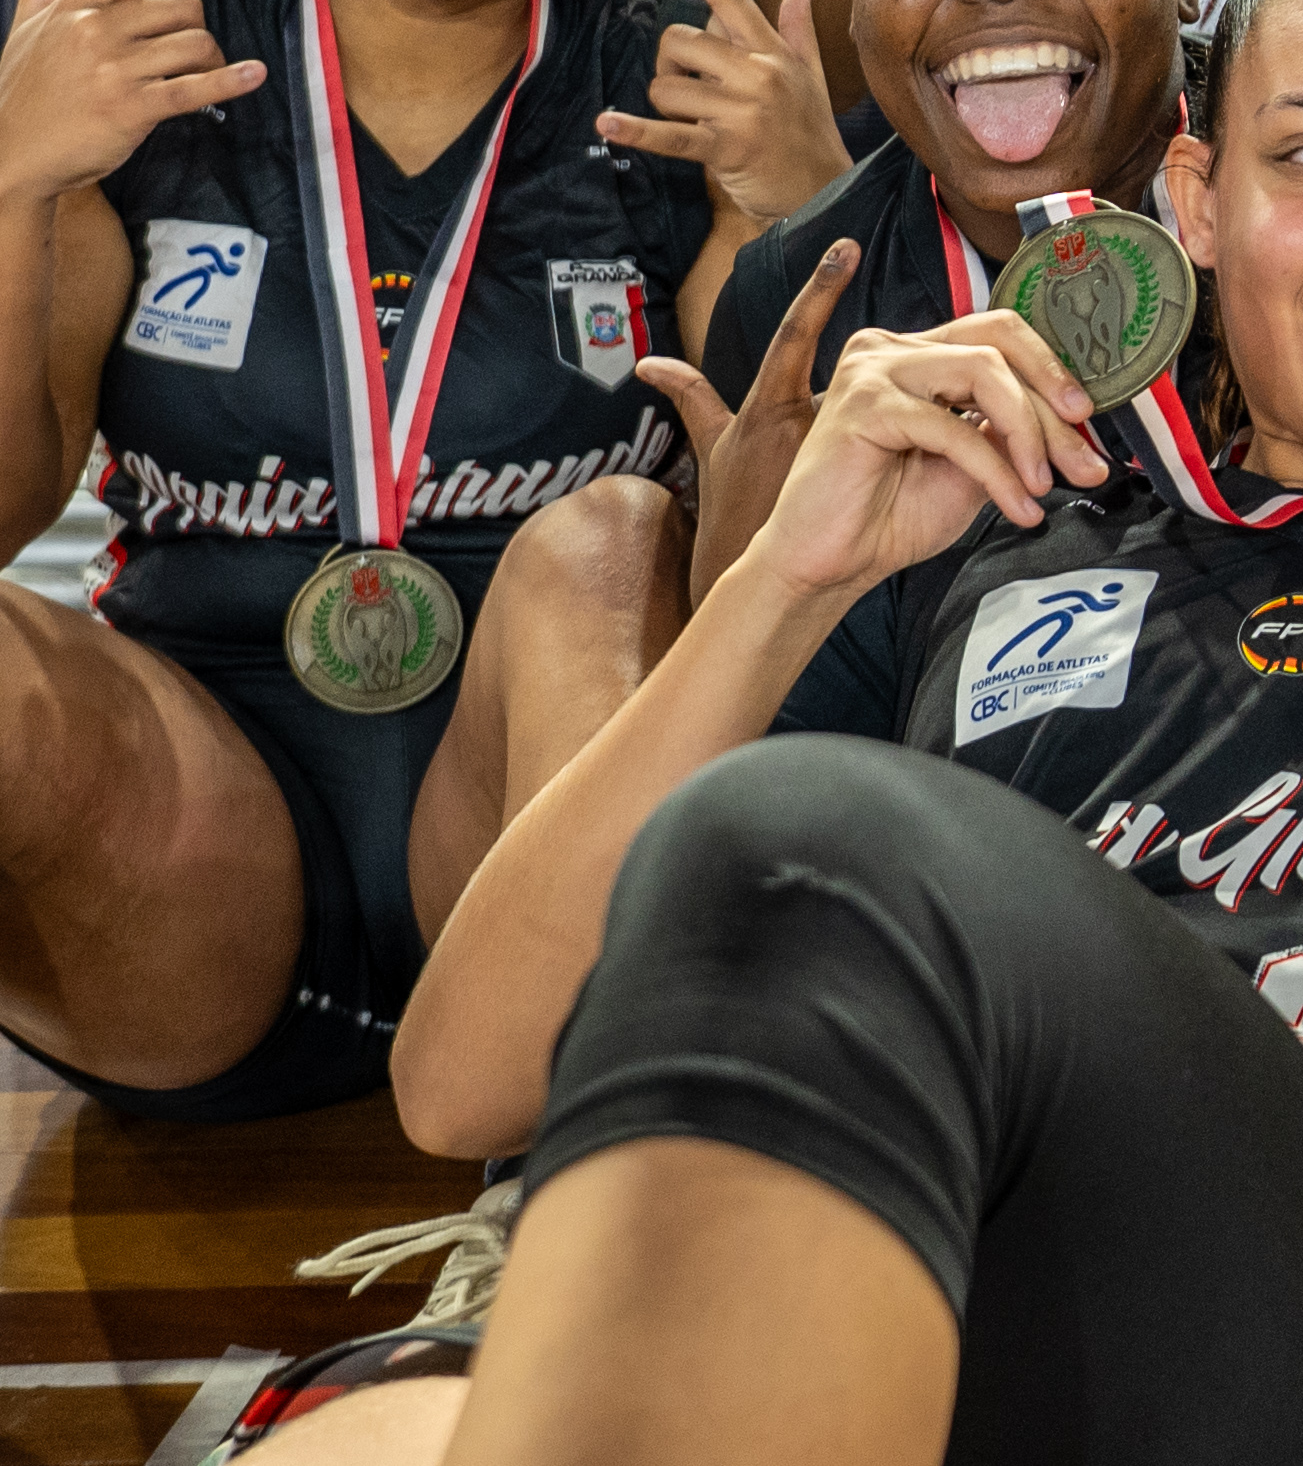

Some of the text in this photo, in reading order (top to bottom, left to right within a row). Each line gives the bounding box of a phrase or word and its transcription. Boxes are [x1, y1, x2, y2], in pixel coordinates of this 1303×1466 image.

[123, 450, 340, 537] Praia
[971, 653, 1109, 694] FORMAÇÃO DE ATLETAS
[970, 689, 1009, 722] CBC
